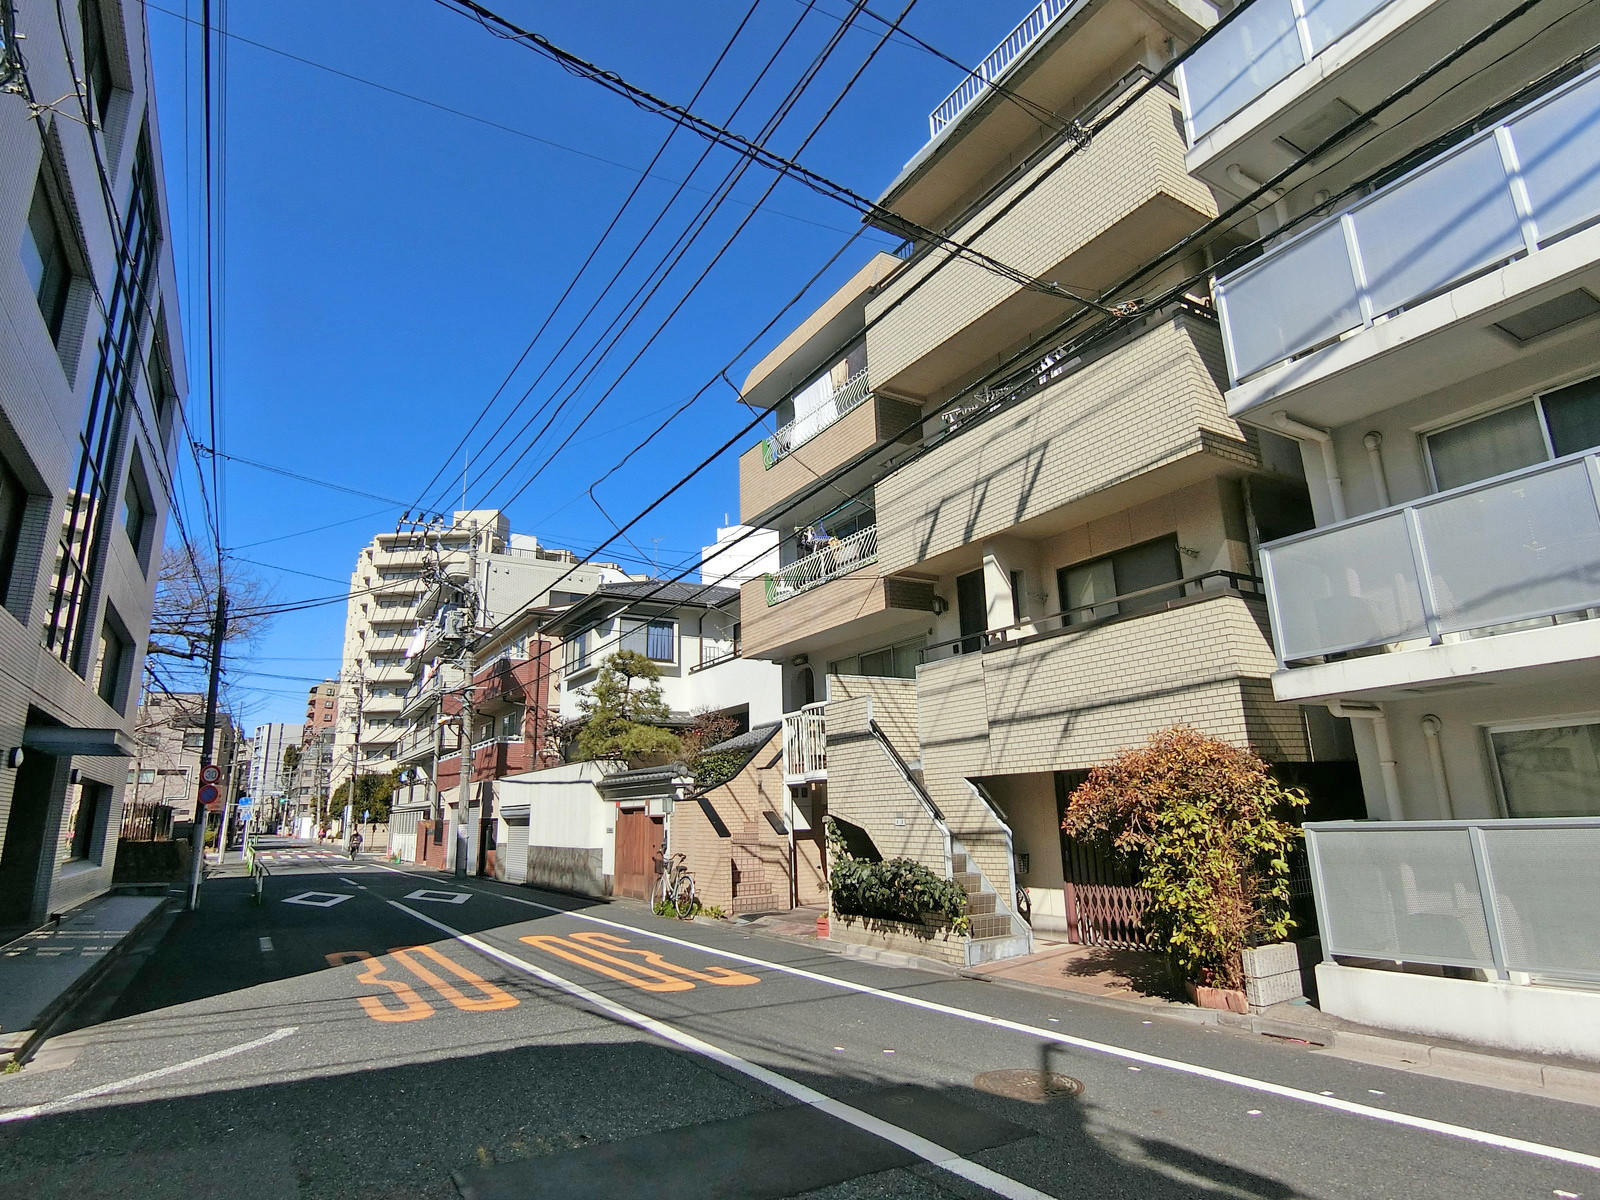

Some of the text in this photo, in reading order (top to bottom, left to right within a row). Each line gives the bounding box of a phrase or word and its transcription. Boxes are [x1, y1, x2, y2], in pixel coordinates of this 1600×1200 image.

[205, 769, 217, 779] 30
[324, 945, 520, 1022] 30
[519, 932, 761, 992] 30
